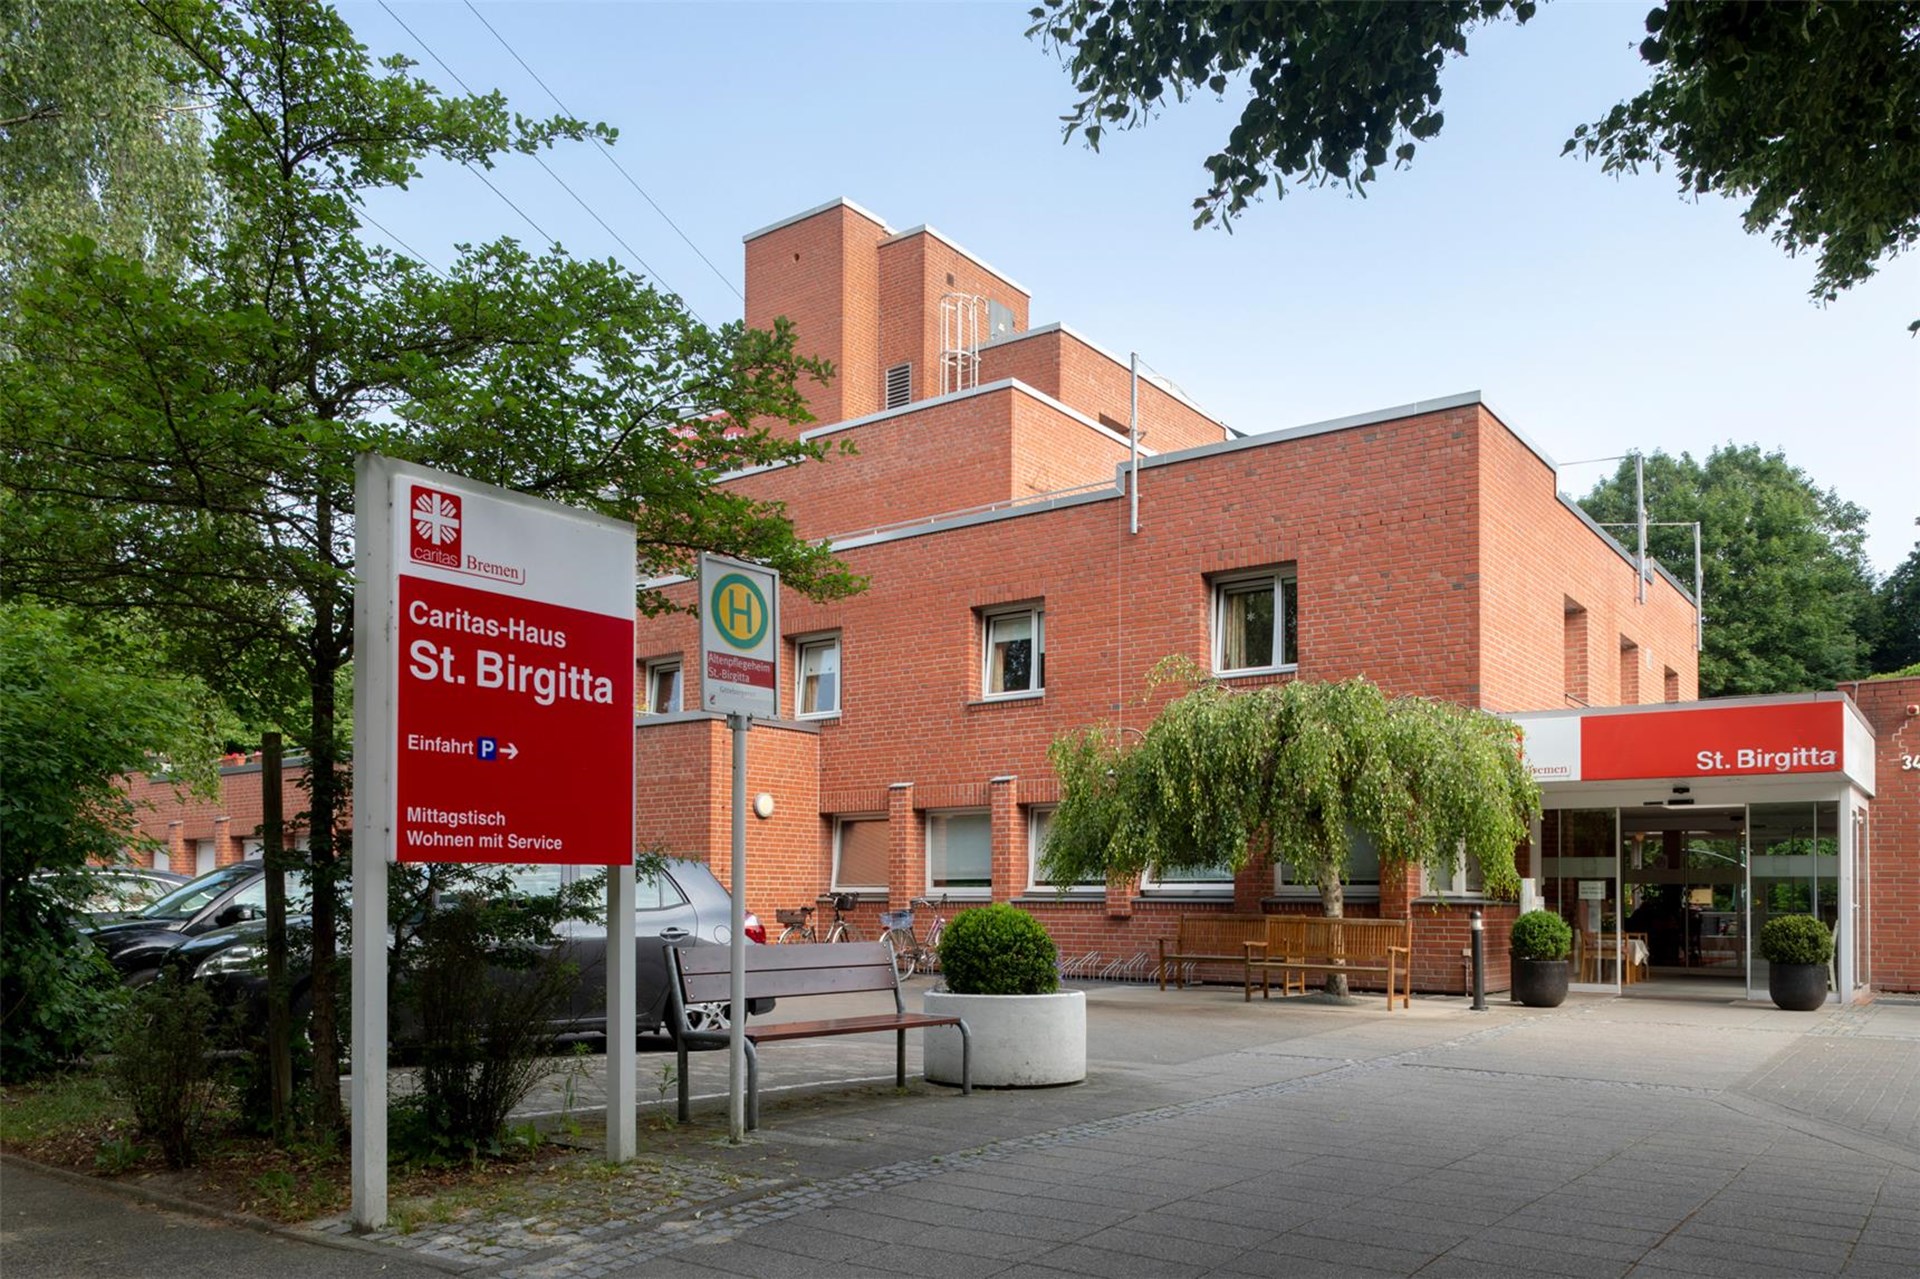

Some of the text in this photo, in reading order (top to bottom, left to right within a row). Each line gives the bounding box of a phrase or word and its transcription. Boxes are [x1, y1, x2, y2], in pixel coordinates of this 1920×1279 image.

[414, 547, 458, 567] caritas
[467, 555, 519, 579] Bremen
[728, 589, 752, 634] H
[409, 600, 567, 648] Caritas-Haus
[409, 639, 614, 706] St. Birgitta
[708, 653, 771, 673] Altenpflegeheim
[407, 734, 474, 755] Einfahrt
[1696, 747, 1837, 771] St. Birgitta
[407, 806, 506, 828] Mittagstisch
[407, 830, 563, 850] Wohnen mit Service
